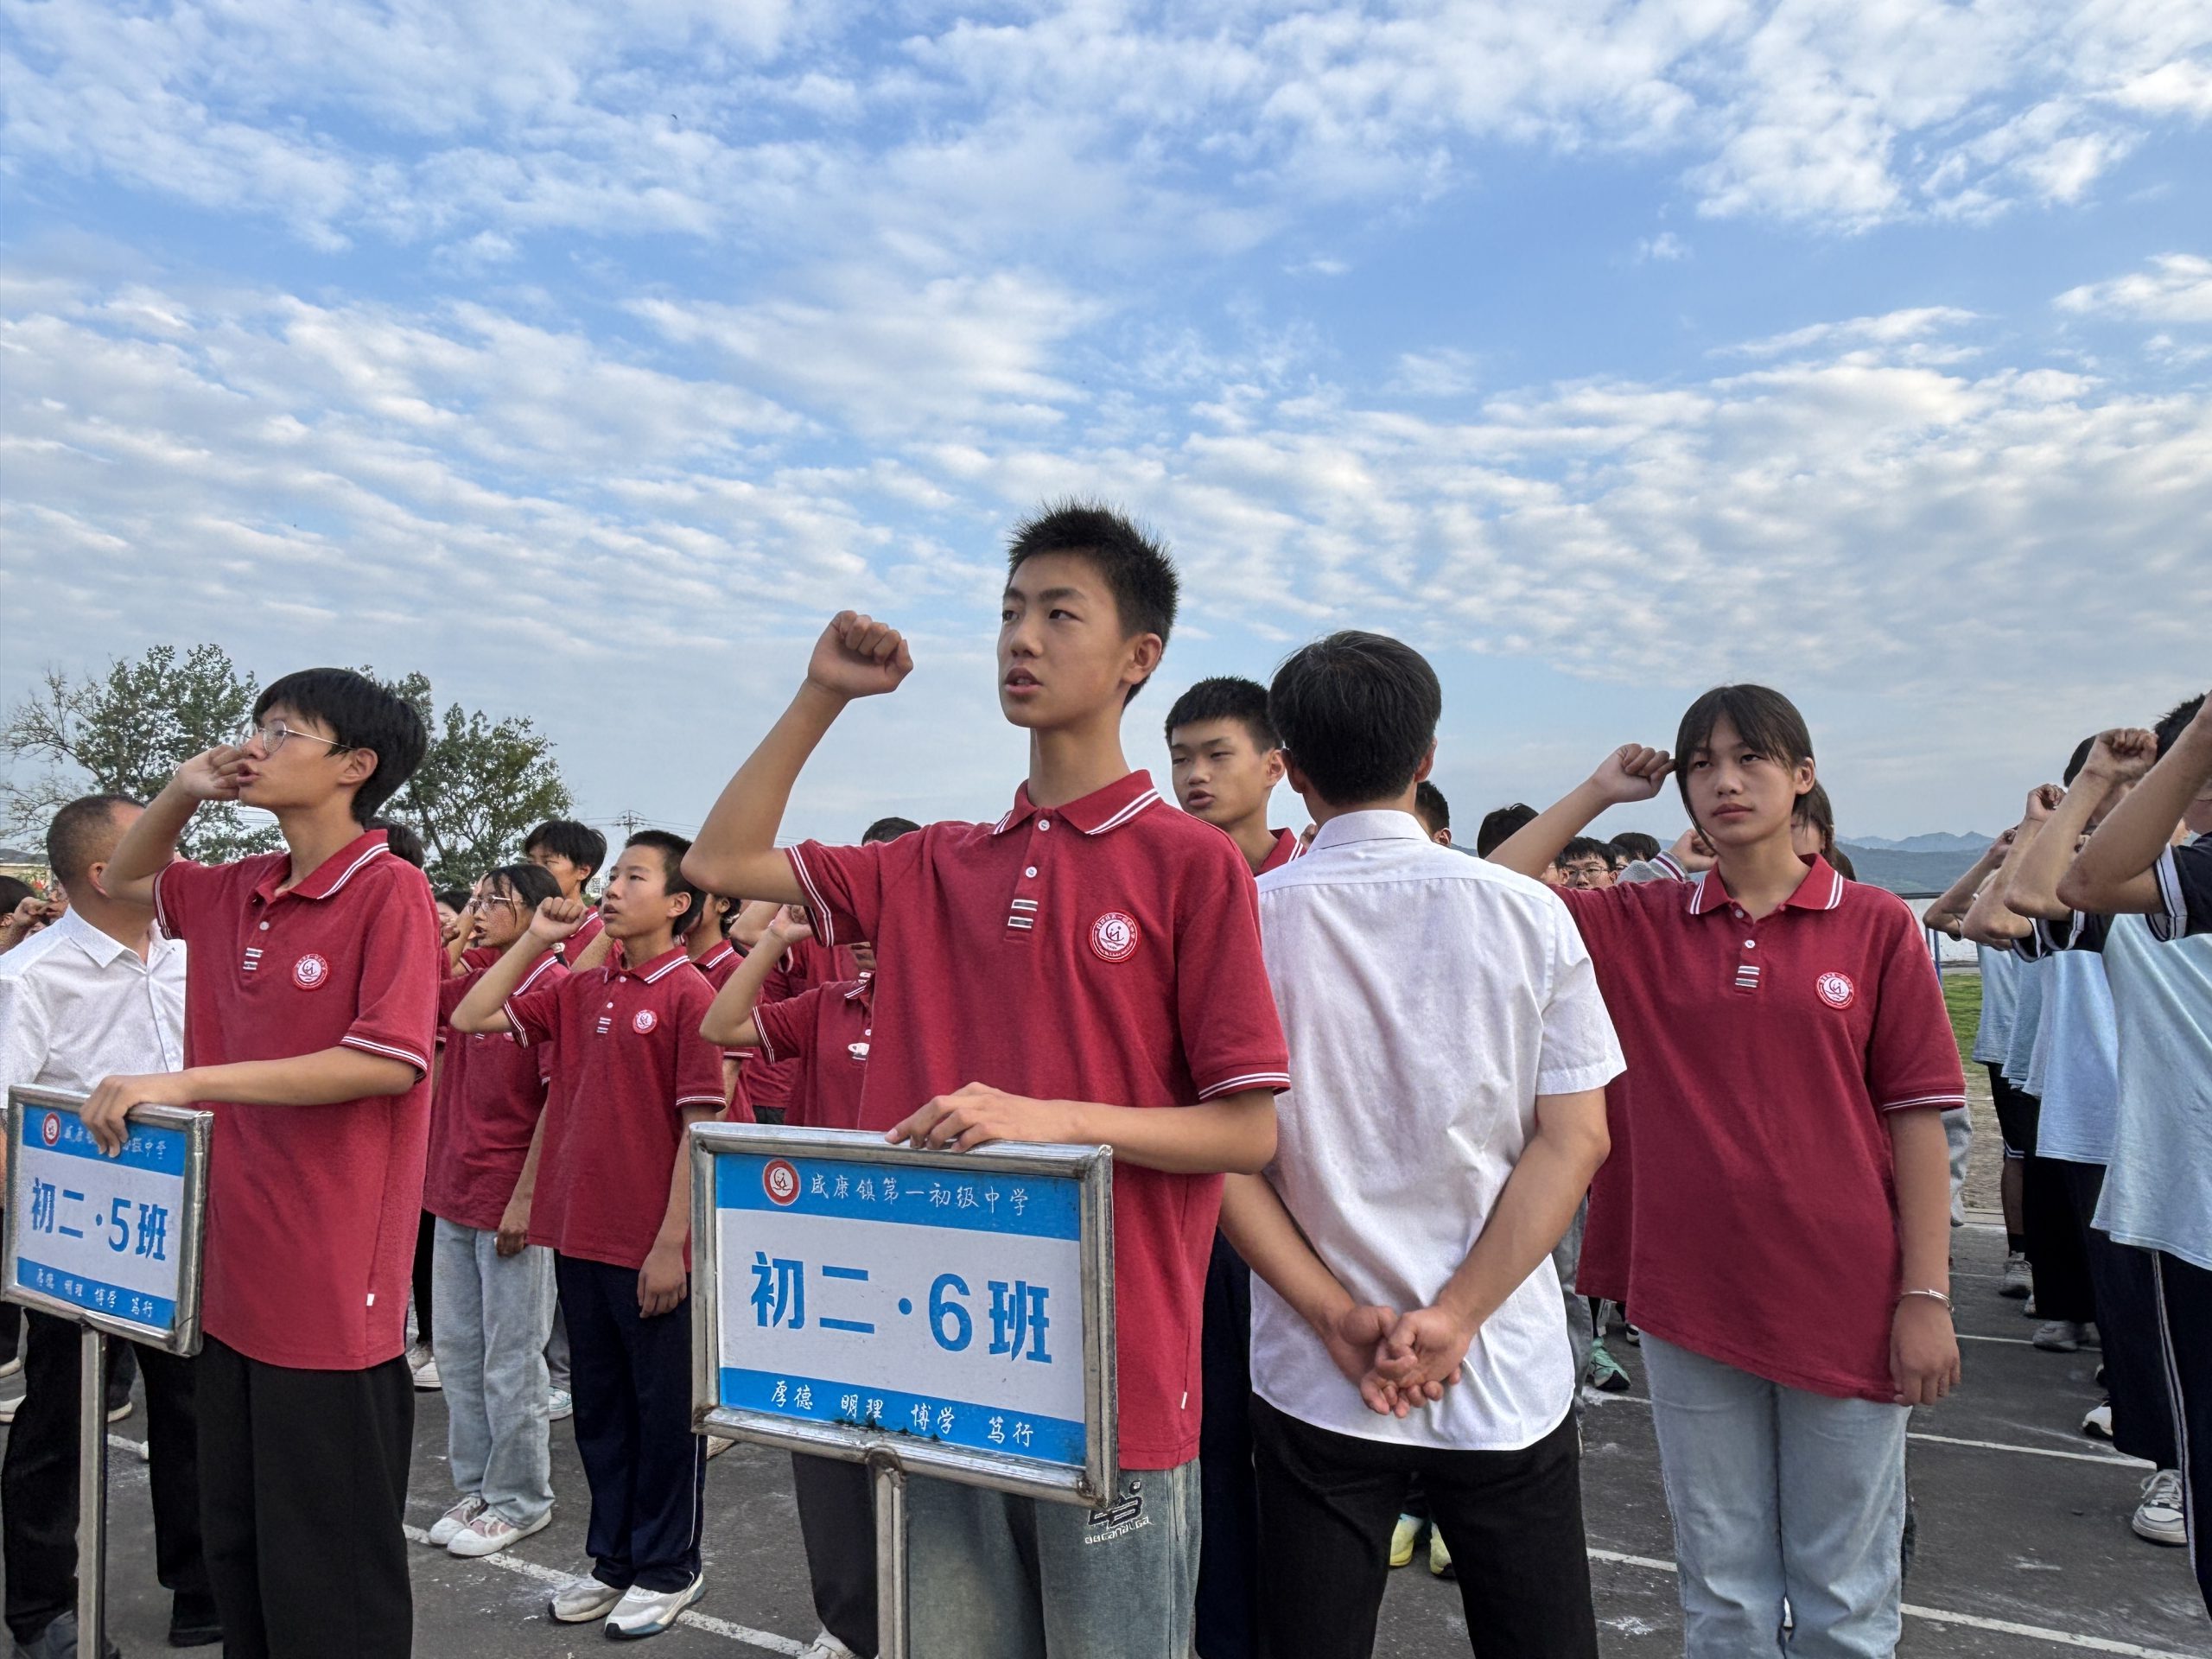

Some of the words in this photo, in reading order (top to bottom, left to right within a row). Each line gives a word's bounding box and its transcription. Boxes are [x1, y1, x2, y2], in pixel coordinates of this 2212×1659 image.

[32, 1177, 168, 1261] 初二·5班
[750, 1251, 1052, 1363] 初二·6班
[772, 1380, 813, 1410] 厚德
[841, 1394, 883, 1419] 明理
[911, 1402, 956, 1434] 博学
[988, 1415, 1034, 1447] 笃行
